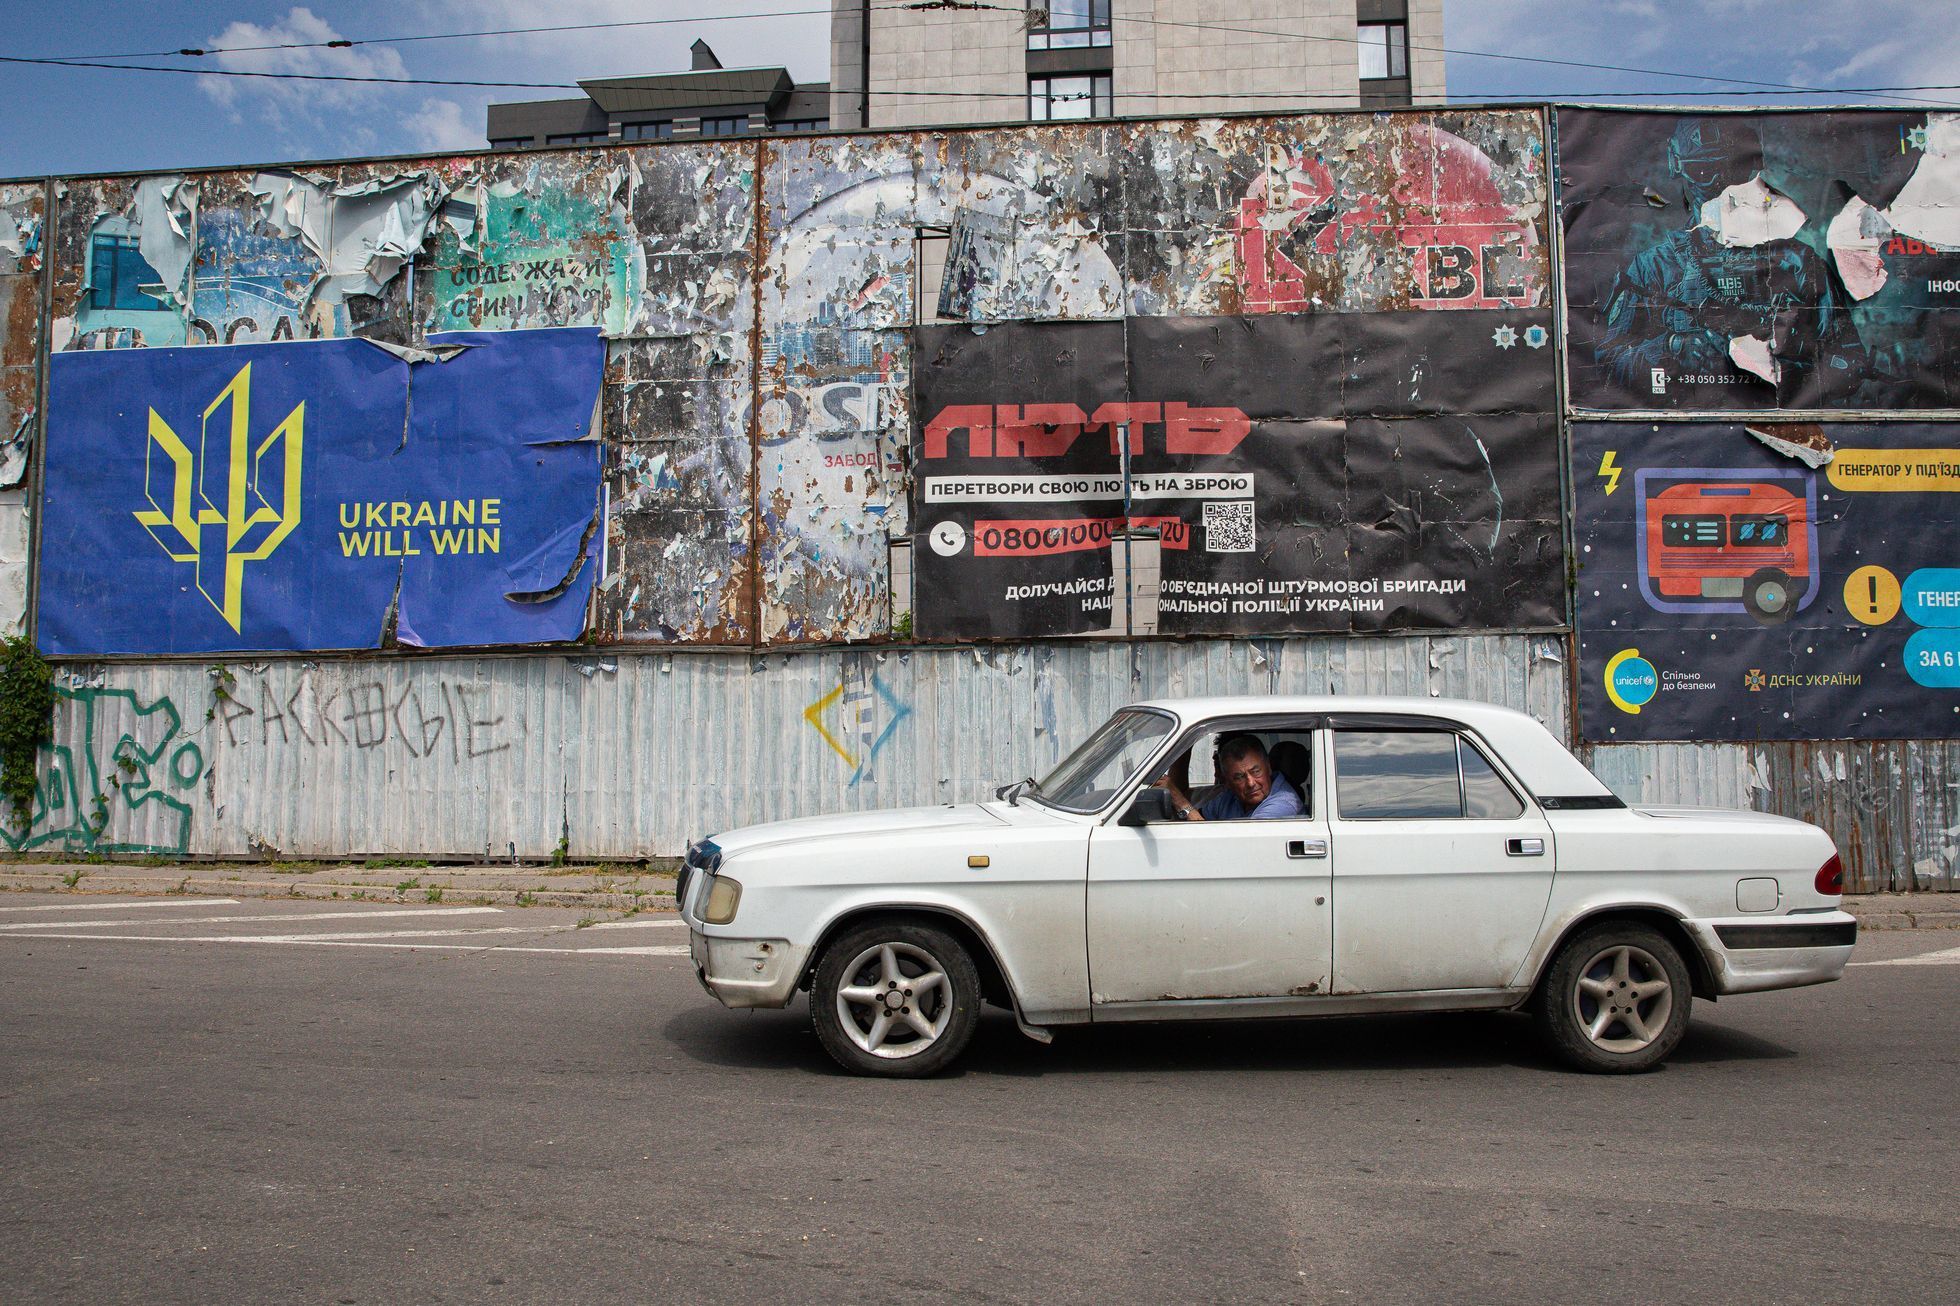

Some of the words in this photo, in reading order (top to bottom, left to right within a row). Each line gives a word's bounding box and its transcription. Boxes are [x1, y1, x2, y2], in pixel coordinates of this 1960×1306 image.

[1678, 375, 1695, 384] +38
[1698, 375, 1715, 384] 050
[1718, 375, 1735, 384] 352
[924, 401, 1251, 459] ЛЮТЬ
[1838, 464, 1901, 476] ГЕНЕРАТОР
[1905, 464, 1912, 476] У
[931, 483, 1034, 495] ПЕРЕТВОРИ
[1039, 481, 1089, 495] СВОЮ
[1155, 479, 1180, 491] НА
[1184, 477, 1247, 491] ЗБРОЮ
[339, 498, 501, 529] UKRAINE
[338, 530, 421, 558] WILL
[429, 527, 501, 556] WIN
[1005, 577, 1104, 600] ДОЛУЧАЙСЯ
[1268, 577, 1378, 594] ШТУРМОВОЇ
[1383, 579, 1466, 595] БРИГАДИ
[1232, 596, 1300, 615] ПОЛІЦІЇ
[1305, 596, 1384, 612] УКРАЇНИ
[1920, 650, 1941, 667] ЗА
[1944, 651, 1954, 667] 6
[1616, 675, 1643, 686] unicef
[1662, 670, 1701, 680] Спільно
[1769, 674, 1802, 688] ДСНС
[1806, 671, 1861, 686] УКРАЇНИ
[1662, 682, 1673, 691] до
[1676, 680, 1716, 690] безпеки
